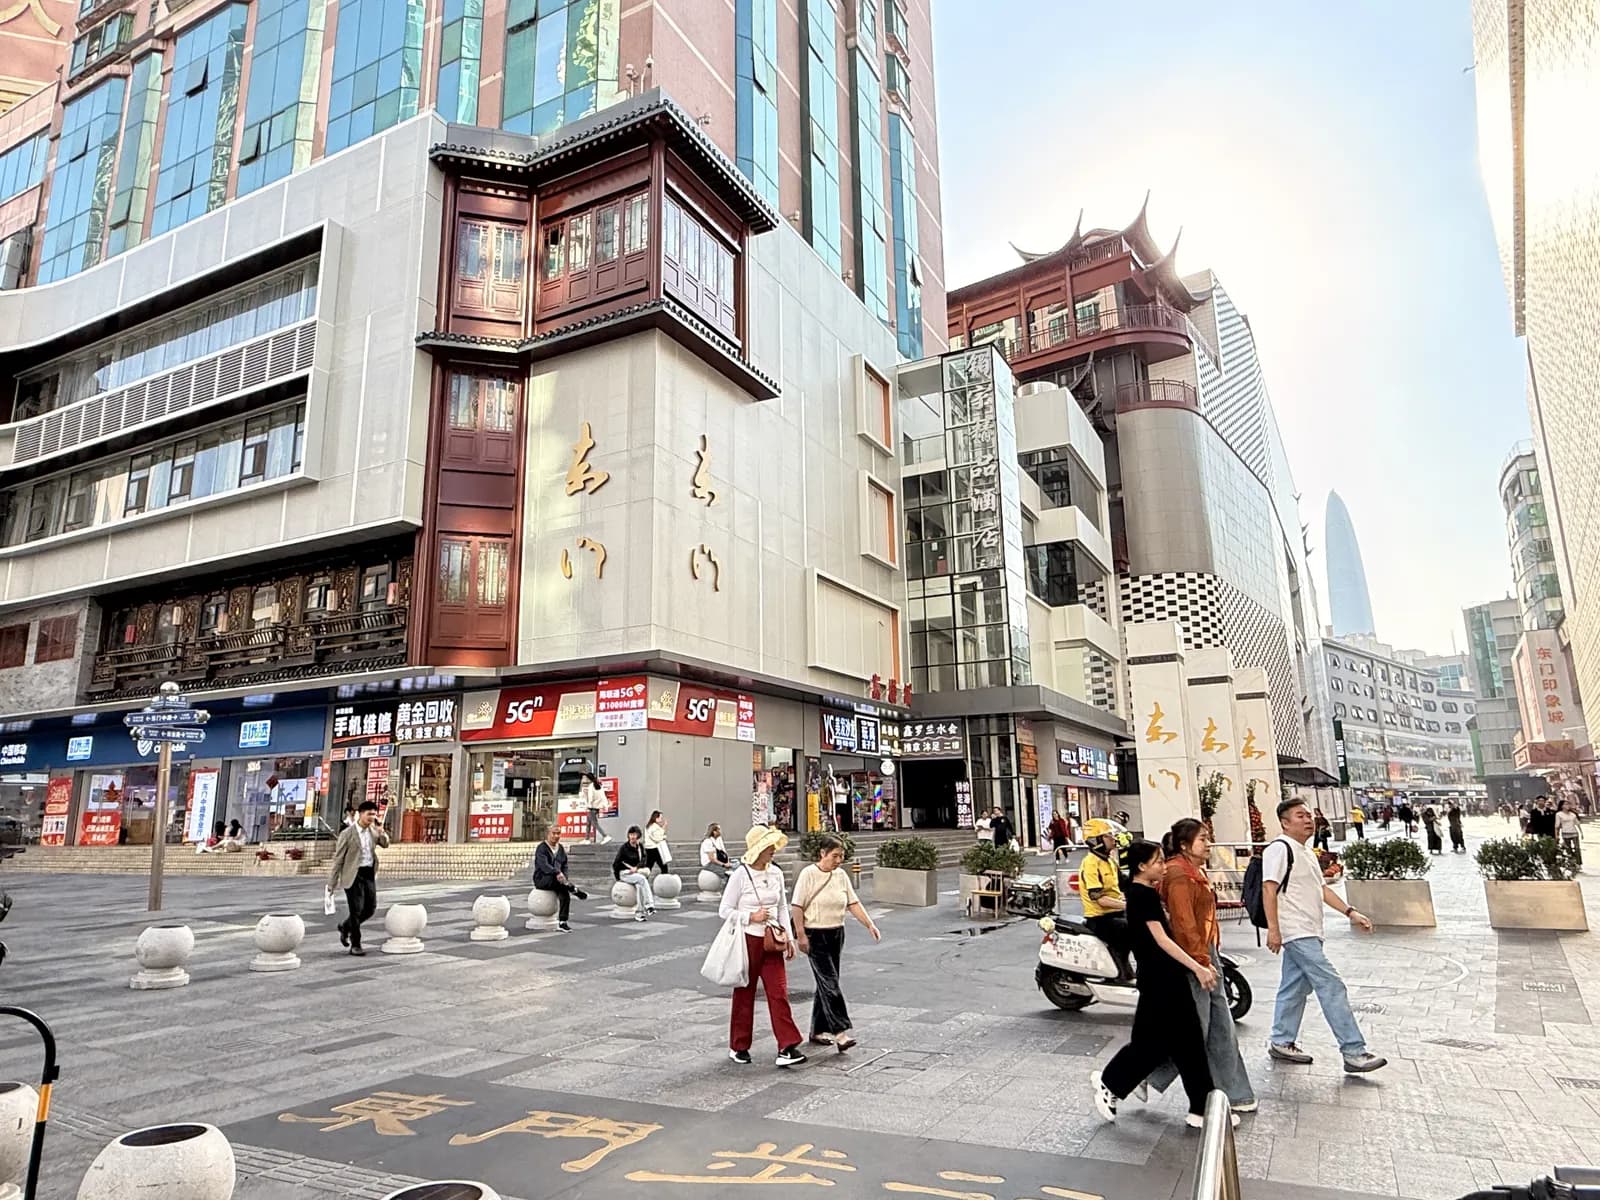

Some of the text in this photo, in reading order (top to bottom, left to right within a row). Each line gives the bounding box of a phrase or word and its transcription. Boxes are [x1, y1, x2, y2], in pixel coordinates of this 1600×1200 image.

[333, 711, 393, 737] 手机维修
[396, 699, 455, 727] 黄金回收
